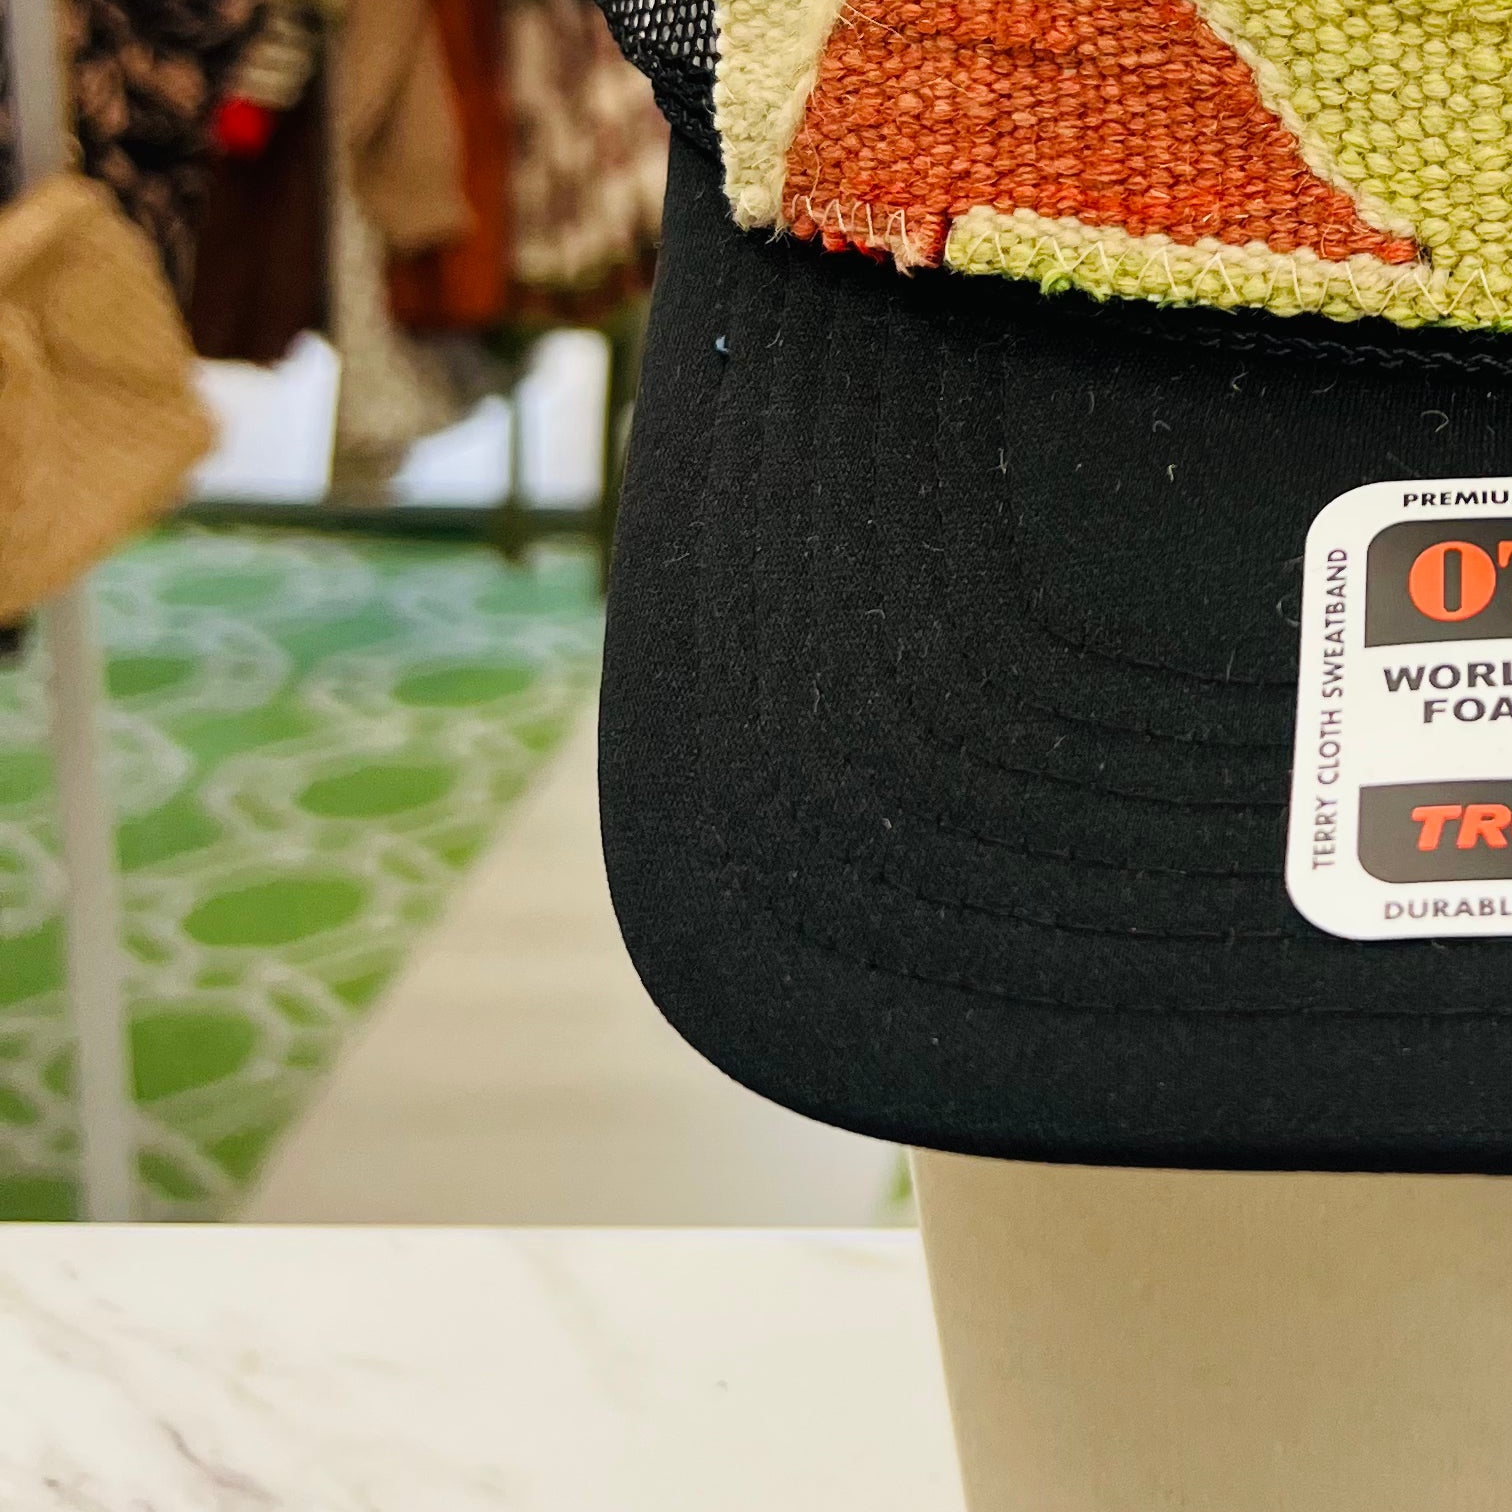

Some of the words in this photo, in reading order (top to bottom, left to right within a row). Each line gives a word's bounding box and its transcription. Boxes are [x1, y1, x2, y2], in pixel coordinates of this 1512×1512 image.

[1321, 549, 1348, 698] SWEATBAND
[1317, 710, 1340, 785] CLOTH
[1311, 797, 1336, 870] TERRY
